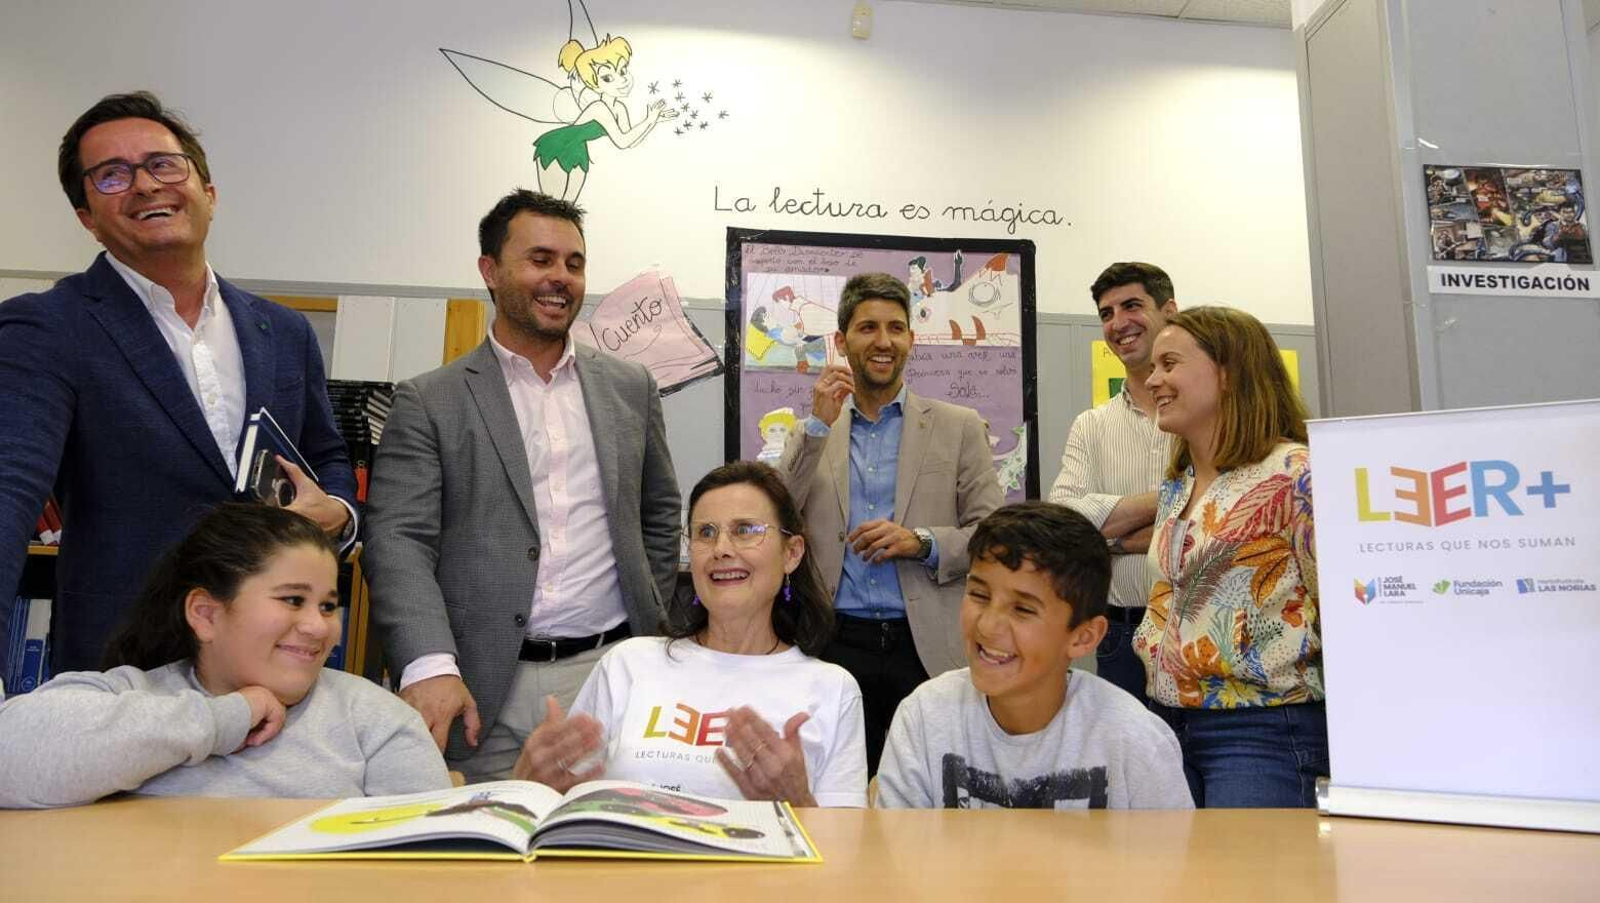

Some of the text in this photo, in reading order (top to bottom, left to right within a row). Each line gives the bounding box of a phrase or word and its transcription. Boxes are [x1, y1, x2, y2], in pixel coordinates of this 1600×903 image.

[714, 185, 1073, 235] La lectura es mágica.
[1440, 273, 1591, 292] INVESTIGACIÓN
[602, 296, 663, 352] Cuento
[1359, 536, 1576, 553] LECTURAS QUE NOS SUMAN
[1383, 575, 1403, 584] JOSÉ
[1453, 579, 1503, 589] Fundación
[1453, 588, 1490, 597] Unicaja
[1558, 584, 1597, 592] NORIAS
[635, 750, 690, 761] LECTURAS
